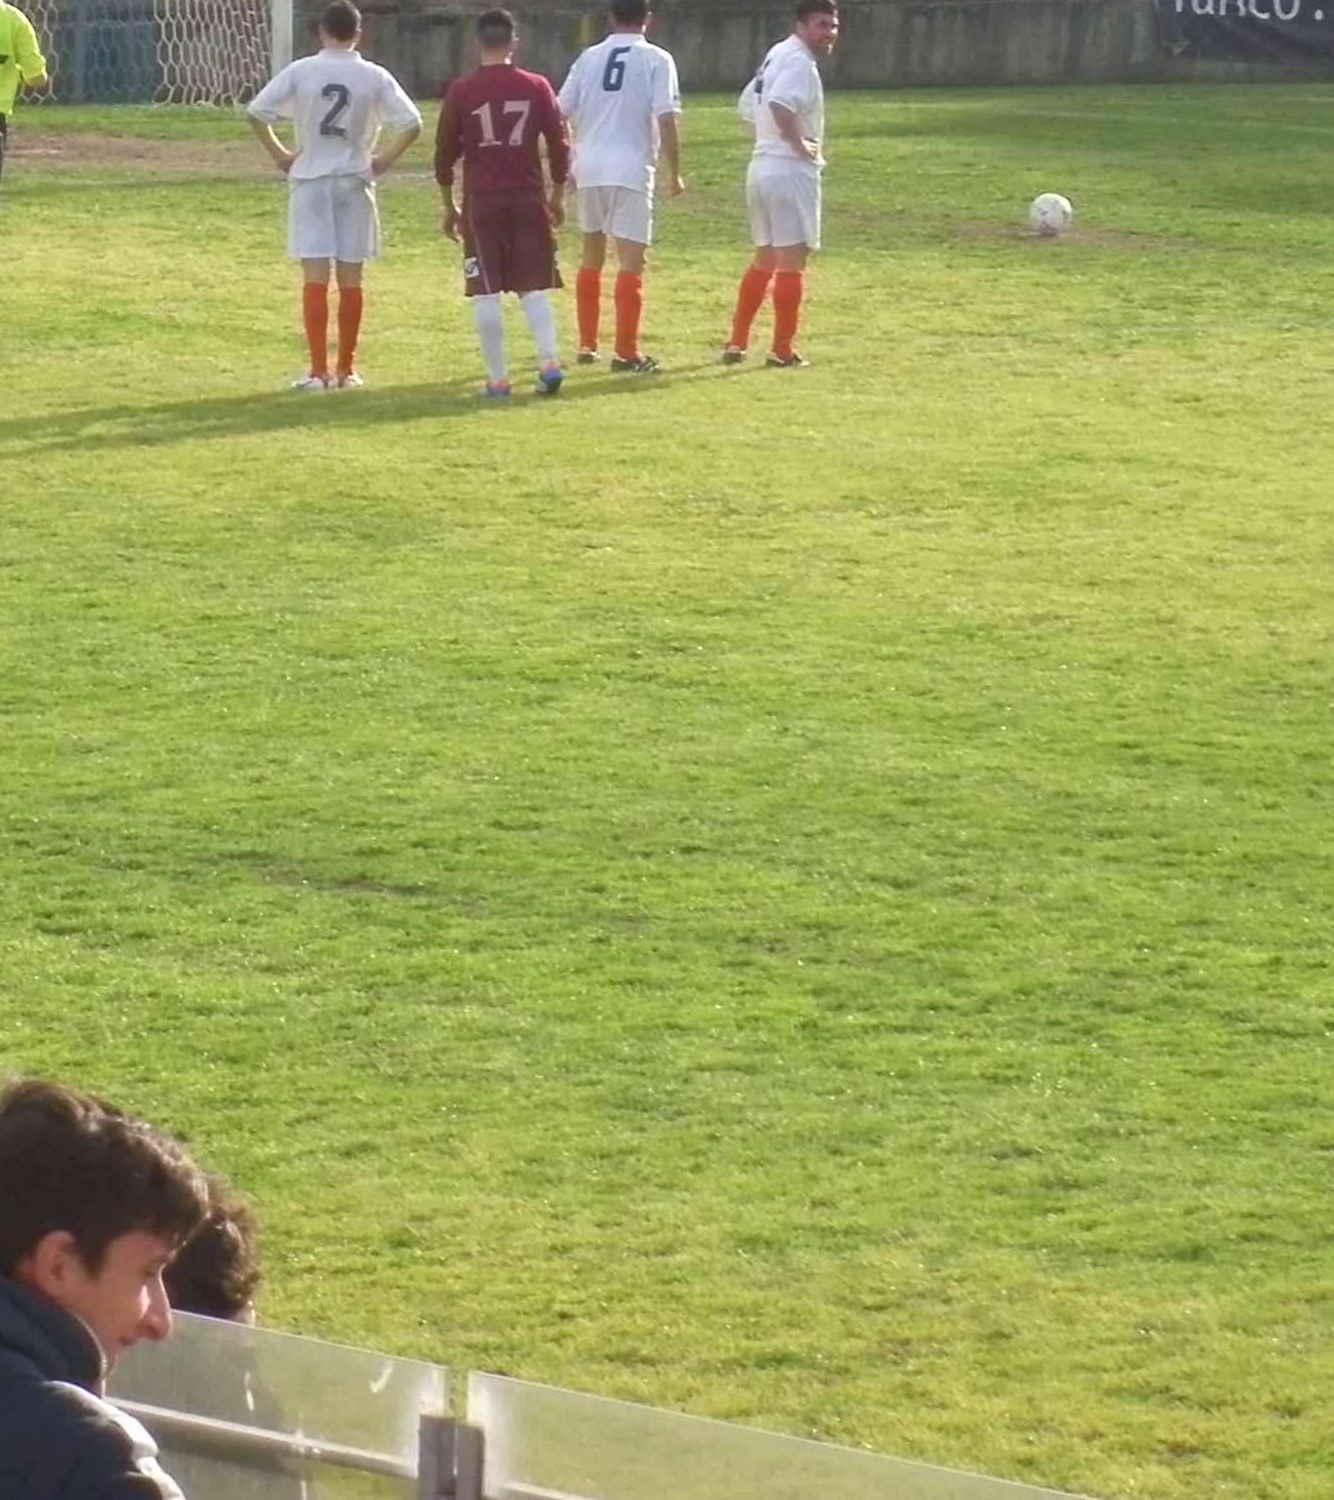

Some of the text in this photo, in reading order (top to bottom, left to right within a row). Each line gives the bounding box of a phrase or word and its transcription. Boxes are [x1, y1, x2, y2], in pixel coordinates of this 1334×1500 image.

[602, 45, 632, 92] 6
[319, 83, 352, 140] 2
[471, 99, 531, 147] 17
